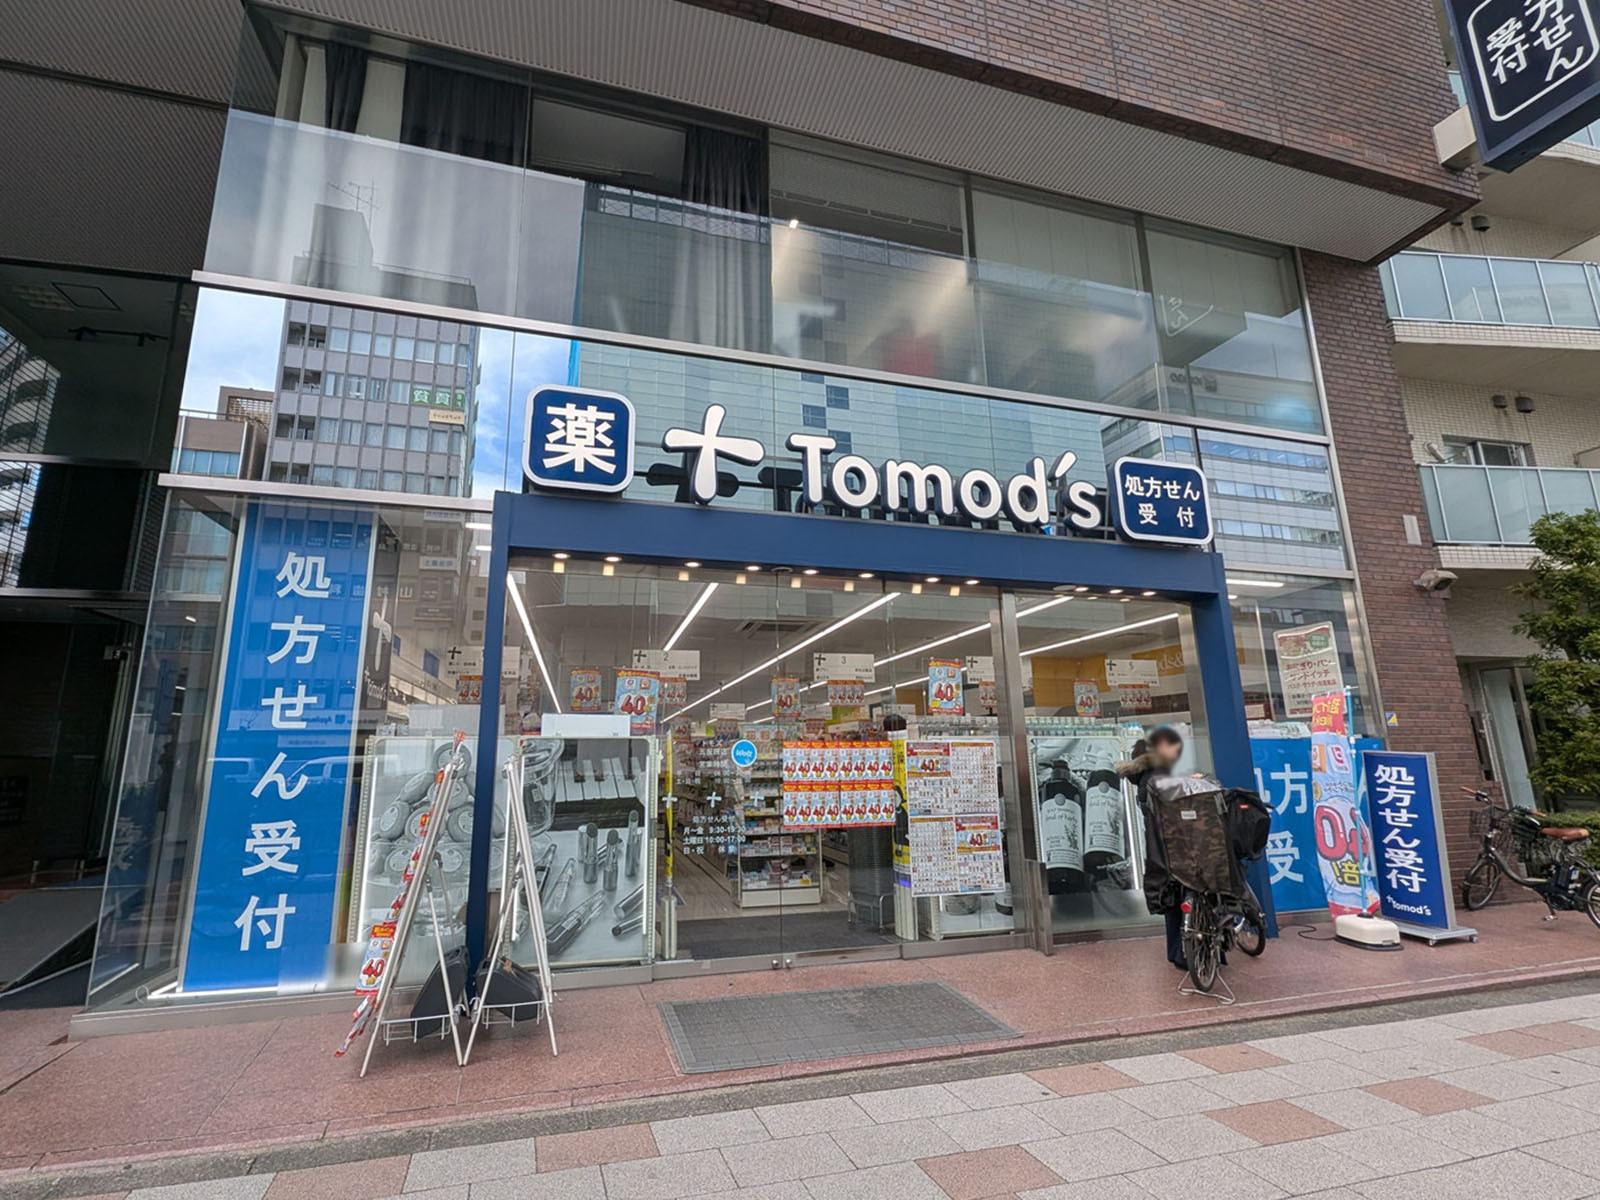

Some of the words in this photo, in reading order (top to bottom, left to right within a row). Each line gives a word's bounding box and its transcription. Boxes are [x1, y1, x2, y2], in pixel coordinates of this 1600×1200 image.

[1486, 16, 1530, 84] 受付
[1524, 0, 1584, 82] 方せん
[542, 402, 616, 474] 薬
[788, 433, 1101, 530] Tomod's
[1124, 473, 1201, 501] 処方せん
[1138, 502, 1196, 529] 受付
[621, 694, 646, 716] 40
[935, 682, 953, 702] 40
[234, 551, 331, 951] 処方せん受付
[1374, 764, 1427, 893] 処方せん受付
[1392, 900, 1432, 916] Tomod's
[362, 959, 385, 978] 40
